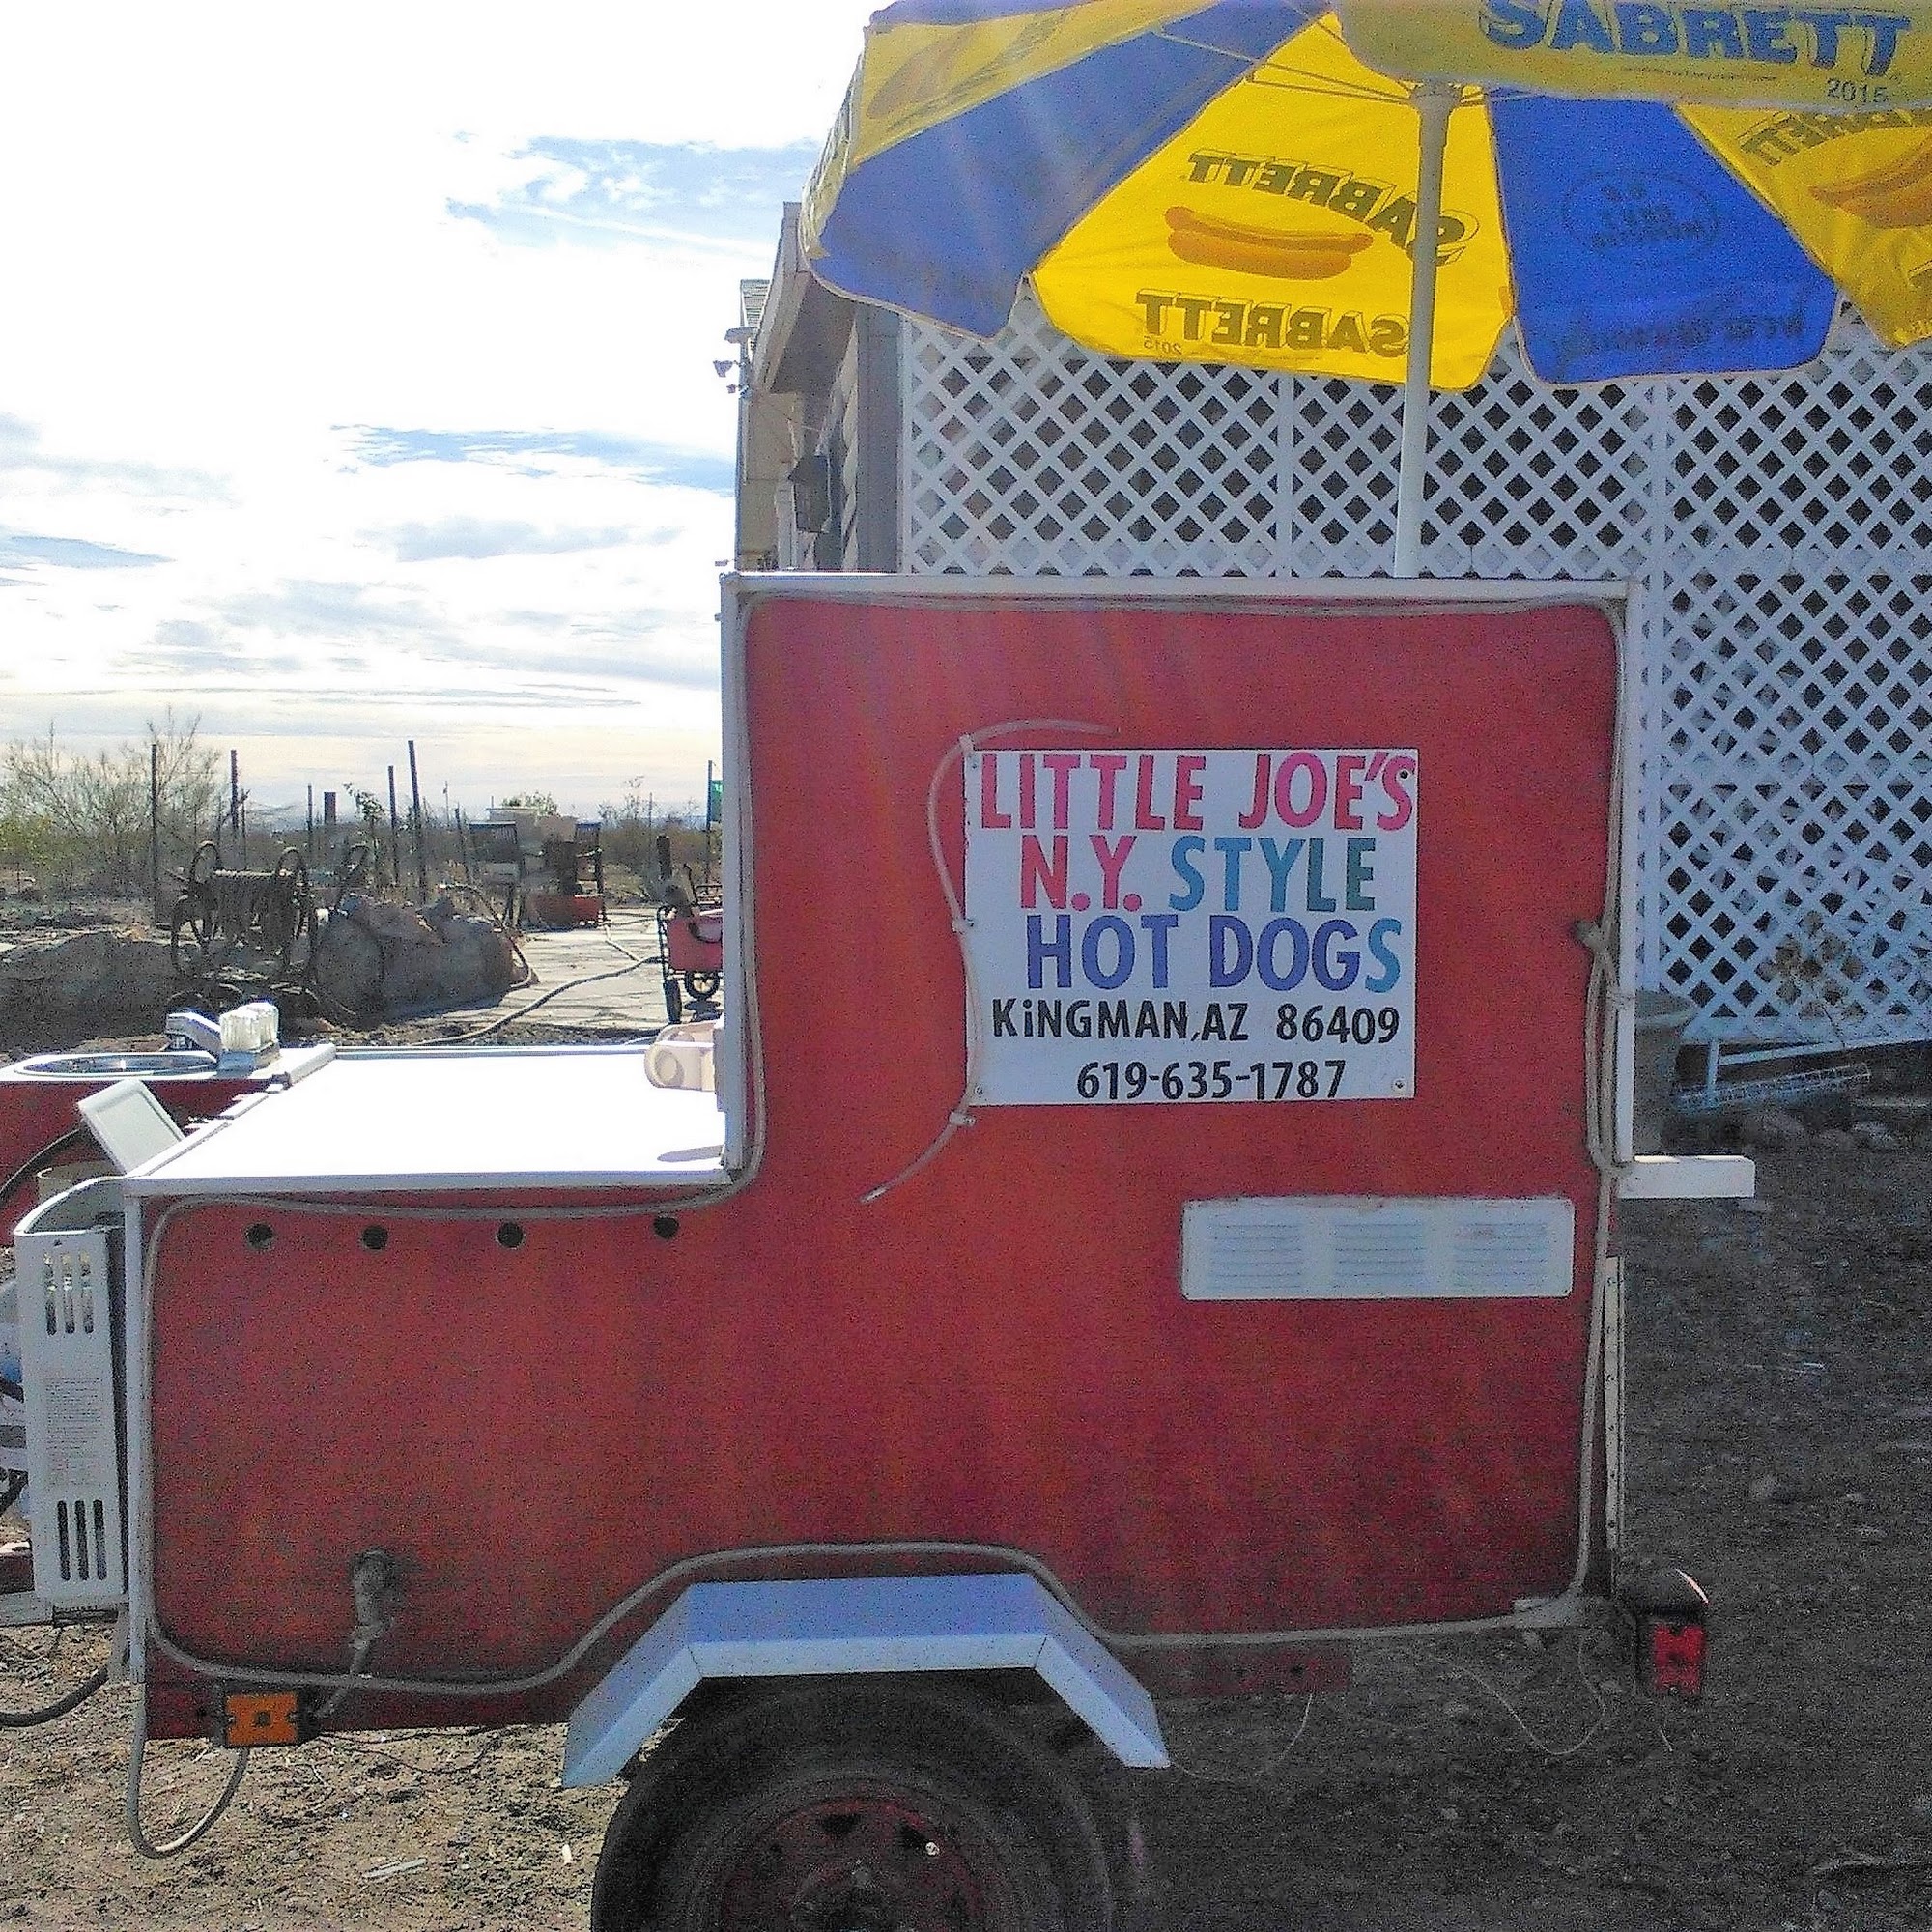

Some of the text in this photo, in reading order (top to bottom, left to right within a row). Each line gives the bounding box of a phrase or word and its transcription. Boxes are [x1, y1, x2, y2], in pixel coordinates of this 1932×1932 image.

[1479, 0, 1912, 76] SABRETT
[1826, 78, 1890, 104] 2015
[980, 752, 1417, 831] LITTLE JOE'S
[1020, 835, 1377, 913] N.Y. STYLE
[1026, 914, 1403, 994] HOT DOGS
[1276, 1004, 1401, 1044] 86409
[1077, 1060, 1347, 1101] 619-635-1787
